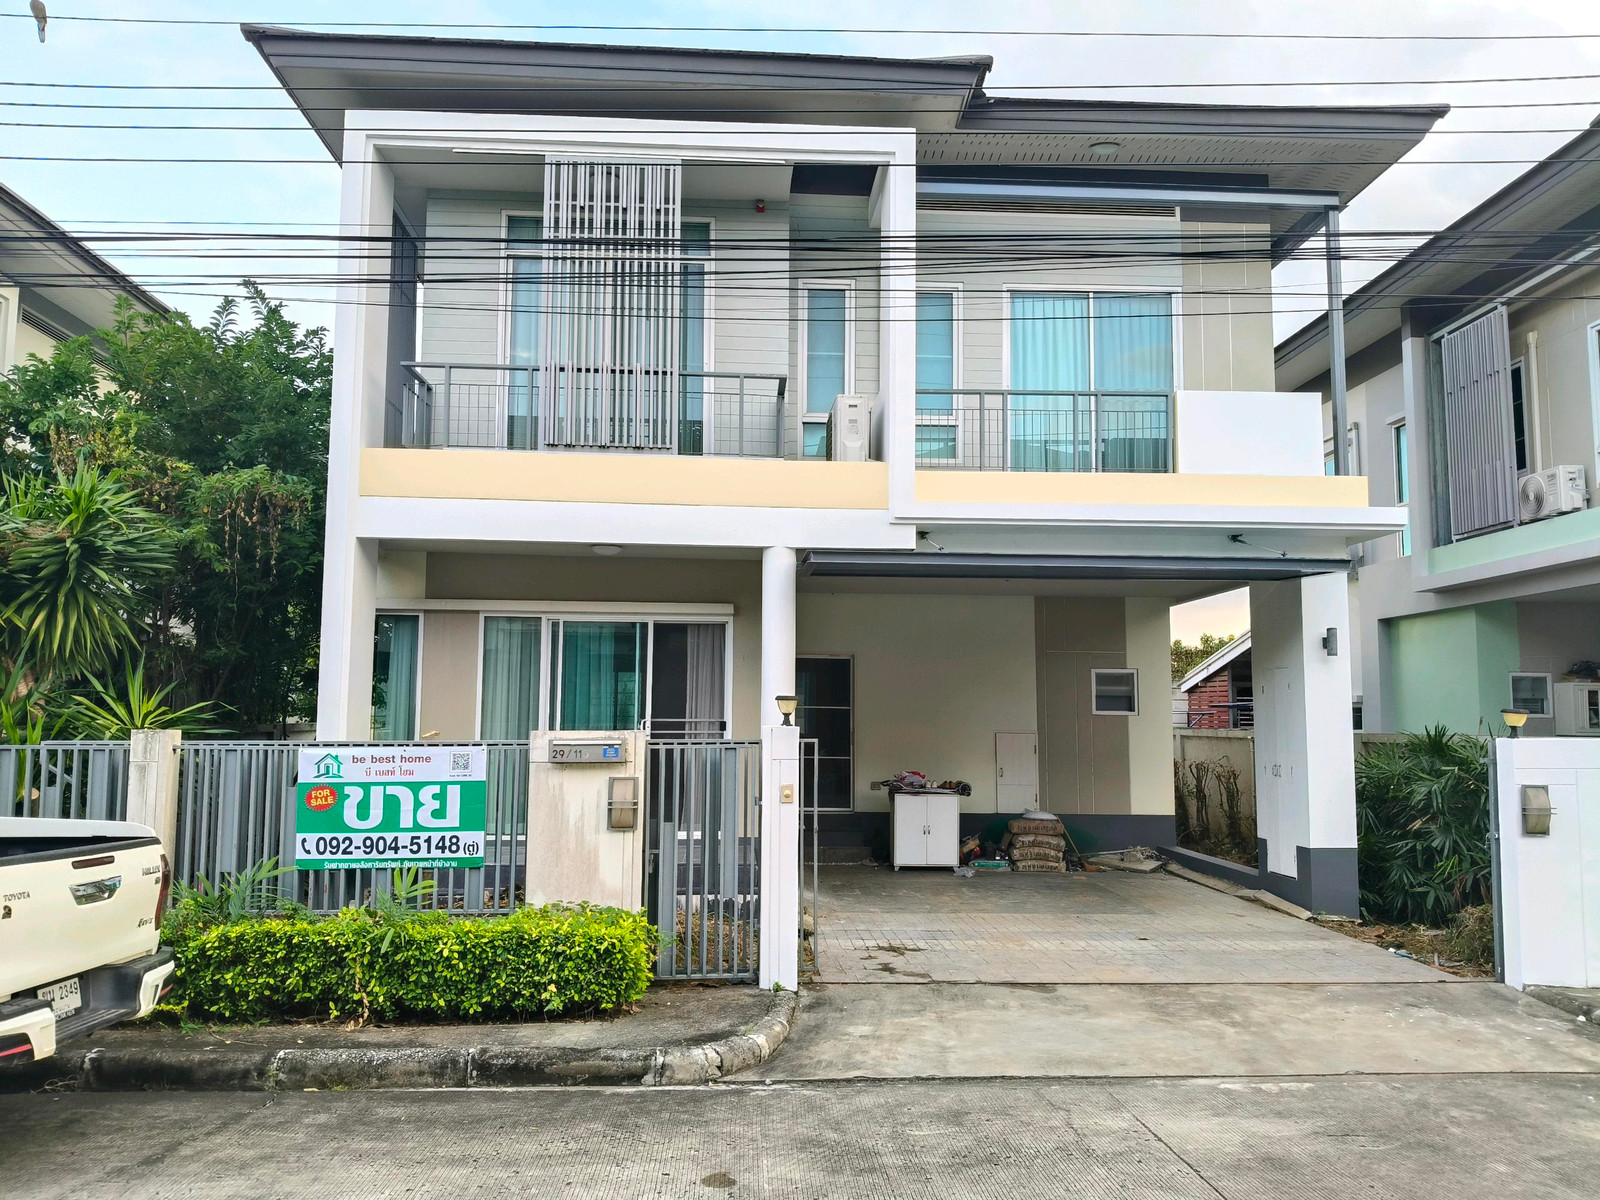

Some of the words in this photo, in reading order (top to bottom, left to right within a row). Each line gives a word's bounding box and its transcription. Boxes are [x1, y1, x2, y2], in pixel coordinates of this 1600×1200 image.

[352, 755, 366, 764] be
[370, 755, 396, 764] best
[400, 755, 432, 764] home
[311, 789, 330, 798] FOR
[310, 796, 334, 807] SALE
[343, 785, 461, 829] ขาย
[315, 835, 460, 855] 092-904-5148
[3, 891, 31, 902] TOYOTA
[59, 981, 78, 1000] 2349
